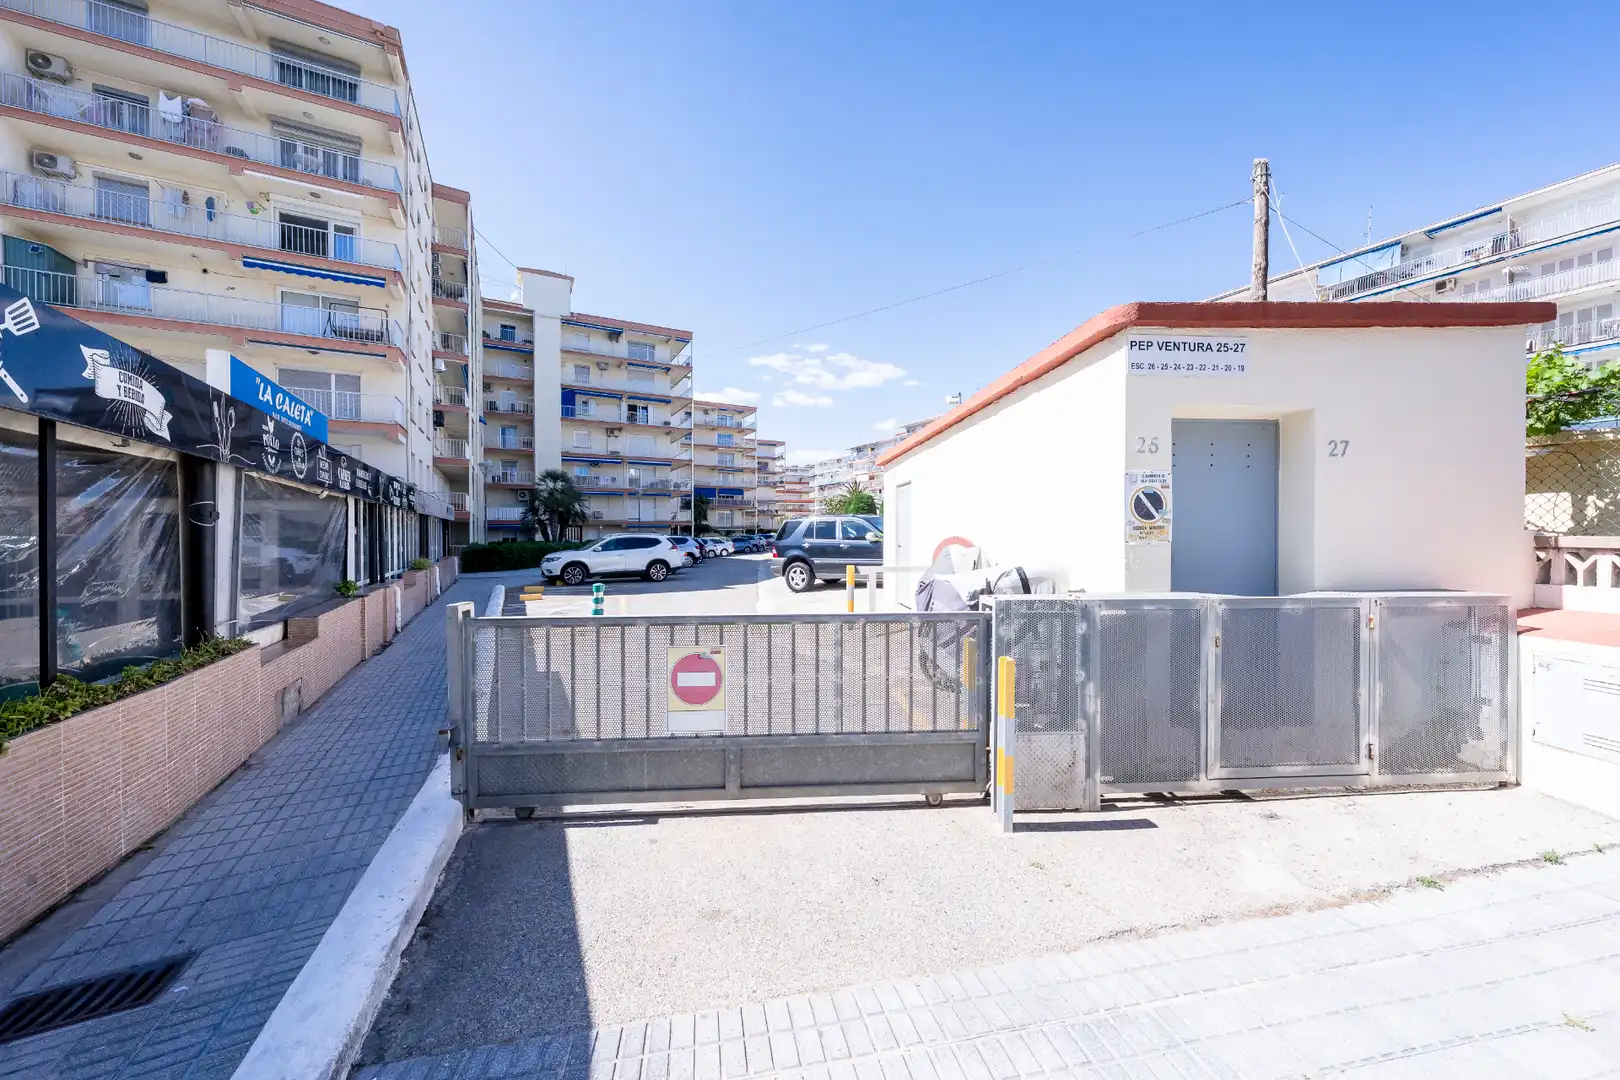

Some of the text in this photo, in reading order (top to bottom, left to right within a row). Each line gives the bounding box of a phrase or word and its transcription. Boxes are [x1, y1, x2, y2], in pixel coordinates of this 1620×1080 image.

[1130, 340, 1246, 353] PEP VENTURA 25-27
[1130, 362, 1147, 370] ESC.
[1160, 363, 1169, 371] 25
[1173, 363, 1182, 371] 24
[1186, 363, 1194, 371] 23
[1199, 364, 1207, 372] 22
[1212, 364, 1219, 372] 21
[1237, 364, 1245, 372] 19
[118, 370, 144, 391] COMIDA
[116, 384, 145, 405] Y BEBIDA
[1328, 439, 1350, 458] 27
